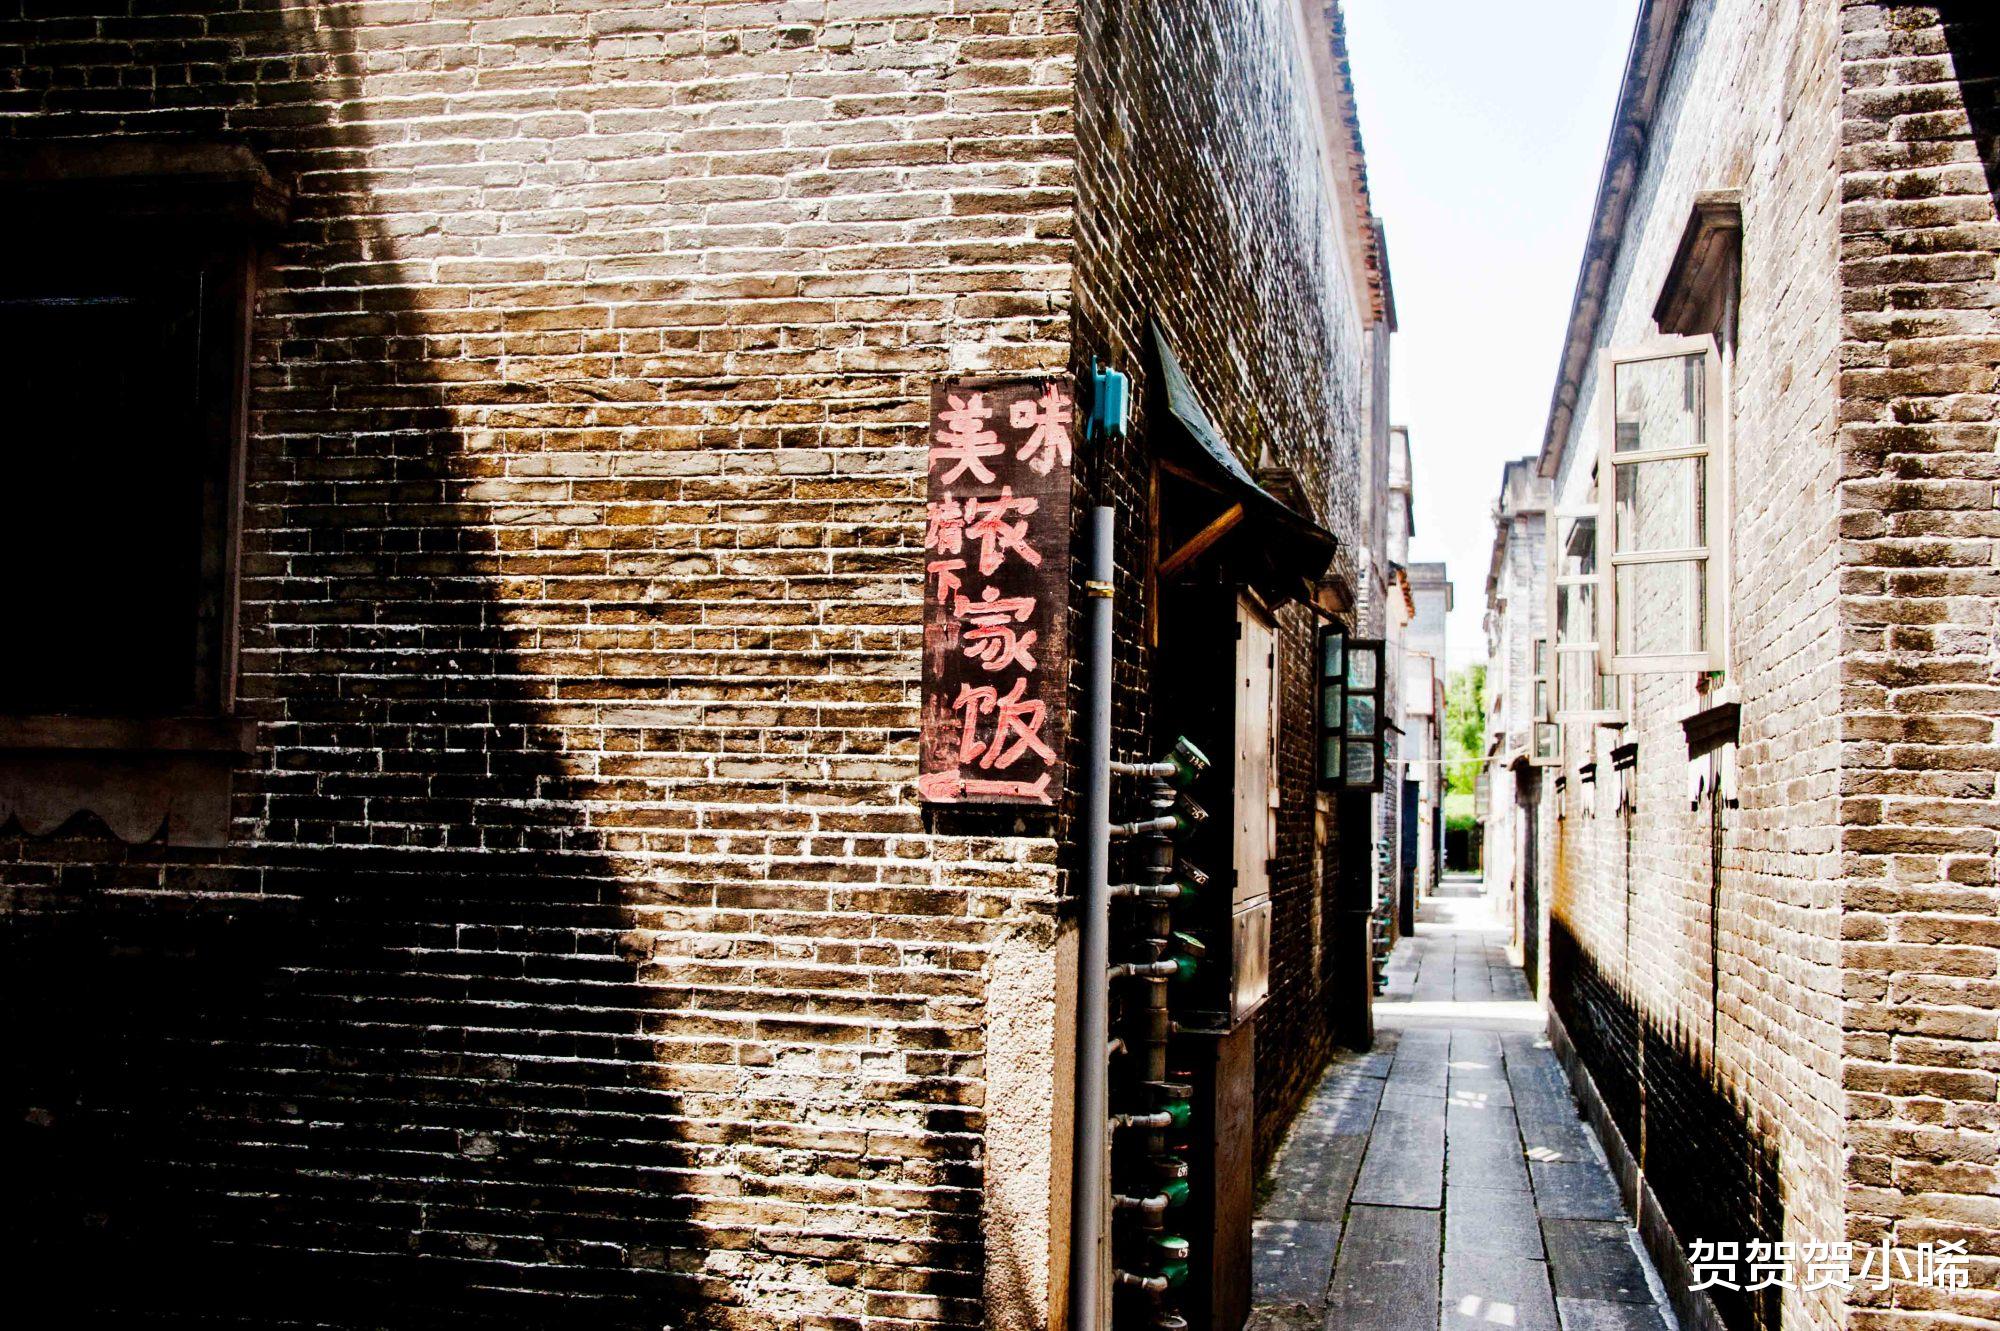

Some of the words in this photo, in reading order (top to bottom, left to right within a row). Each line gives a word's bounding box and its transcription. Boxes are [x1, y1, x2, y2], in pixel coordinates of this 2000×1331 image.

[928, 383, 1072, 485] 美味
[953, 485, 1056, 770] 农家饭
